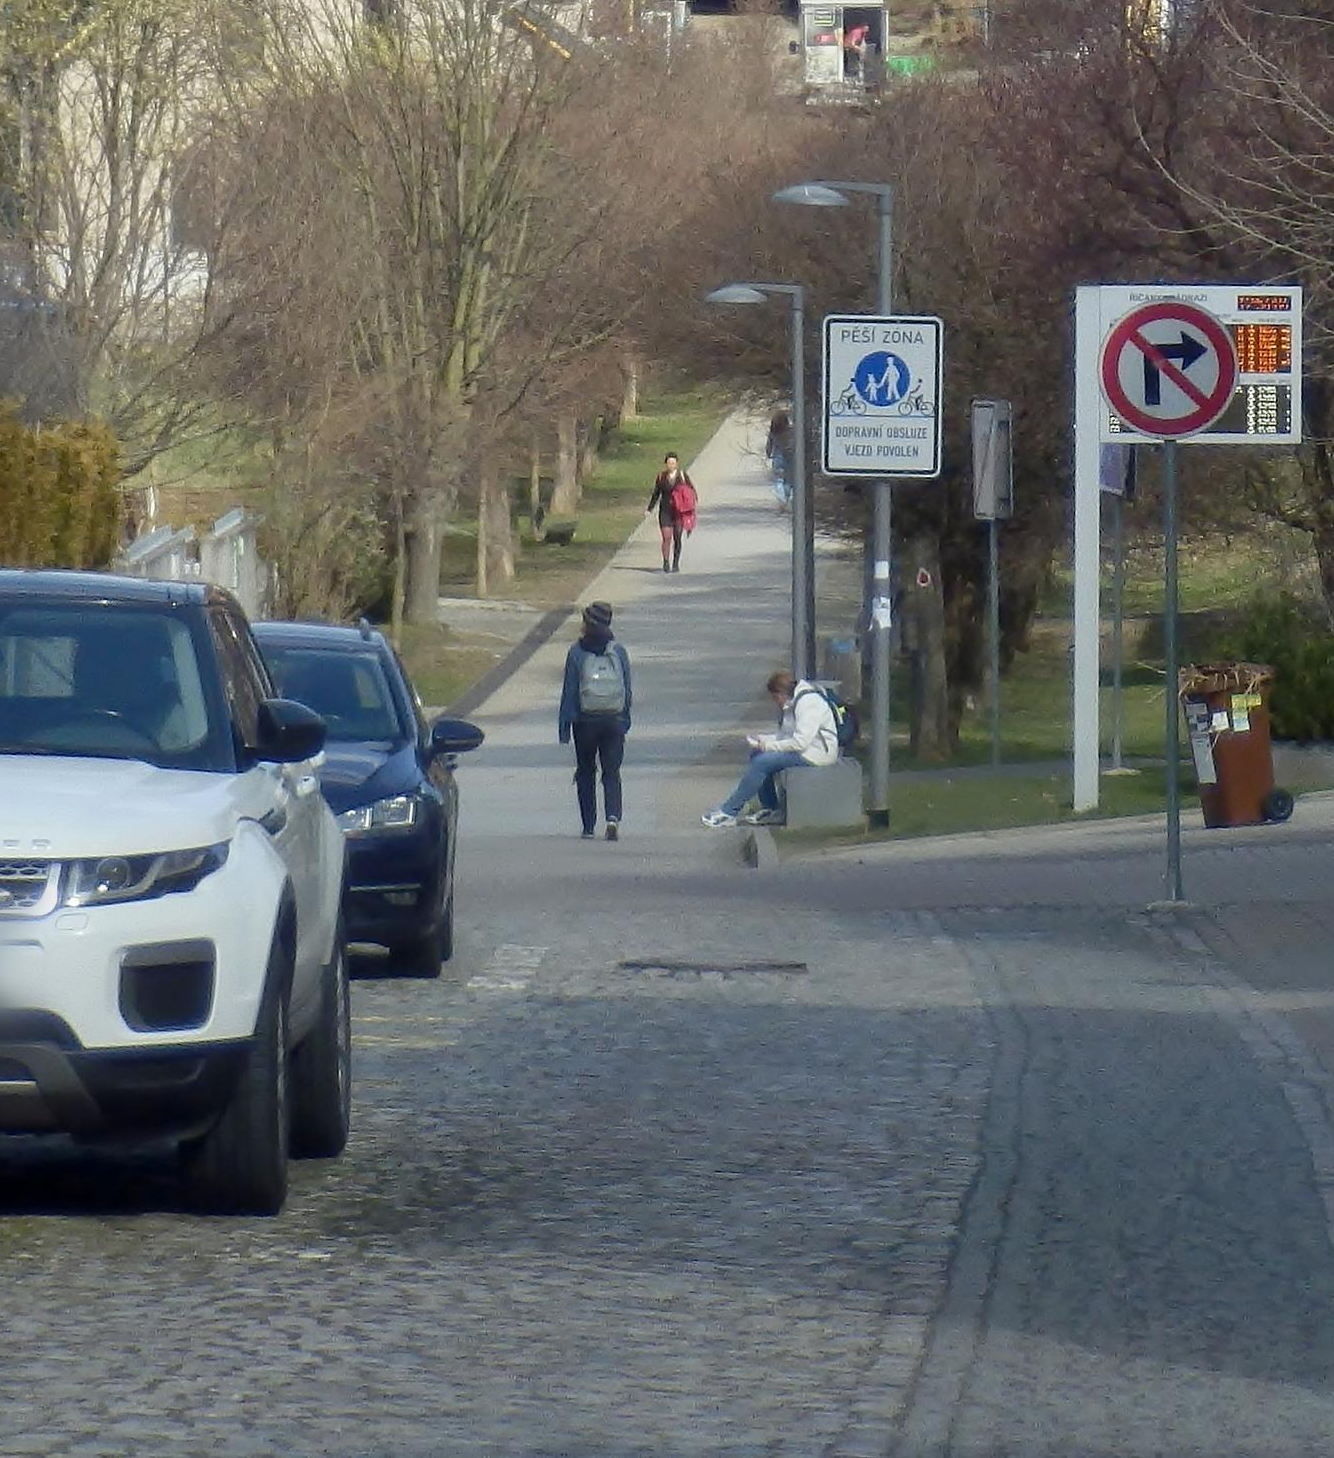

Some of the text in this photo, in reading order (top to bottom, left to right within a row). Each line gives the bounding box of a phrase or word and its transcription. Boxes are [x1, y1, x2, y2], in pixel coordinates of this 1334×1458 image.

[882, 327, 924, 344] ZÓNA
[835, 425, 928, 440] DOPRAVNÍ OBSLUZE
[844, 444, 919, 457] VJEZD POVOLEN
